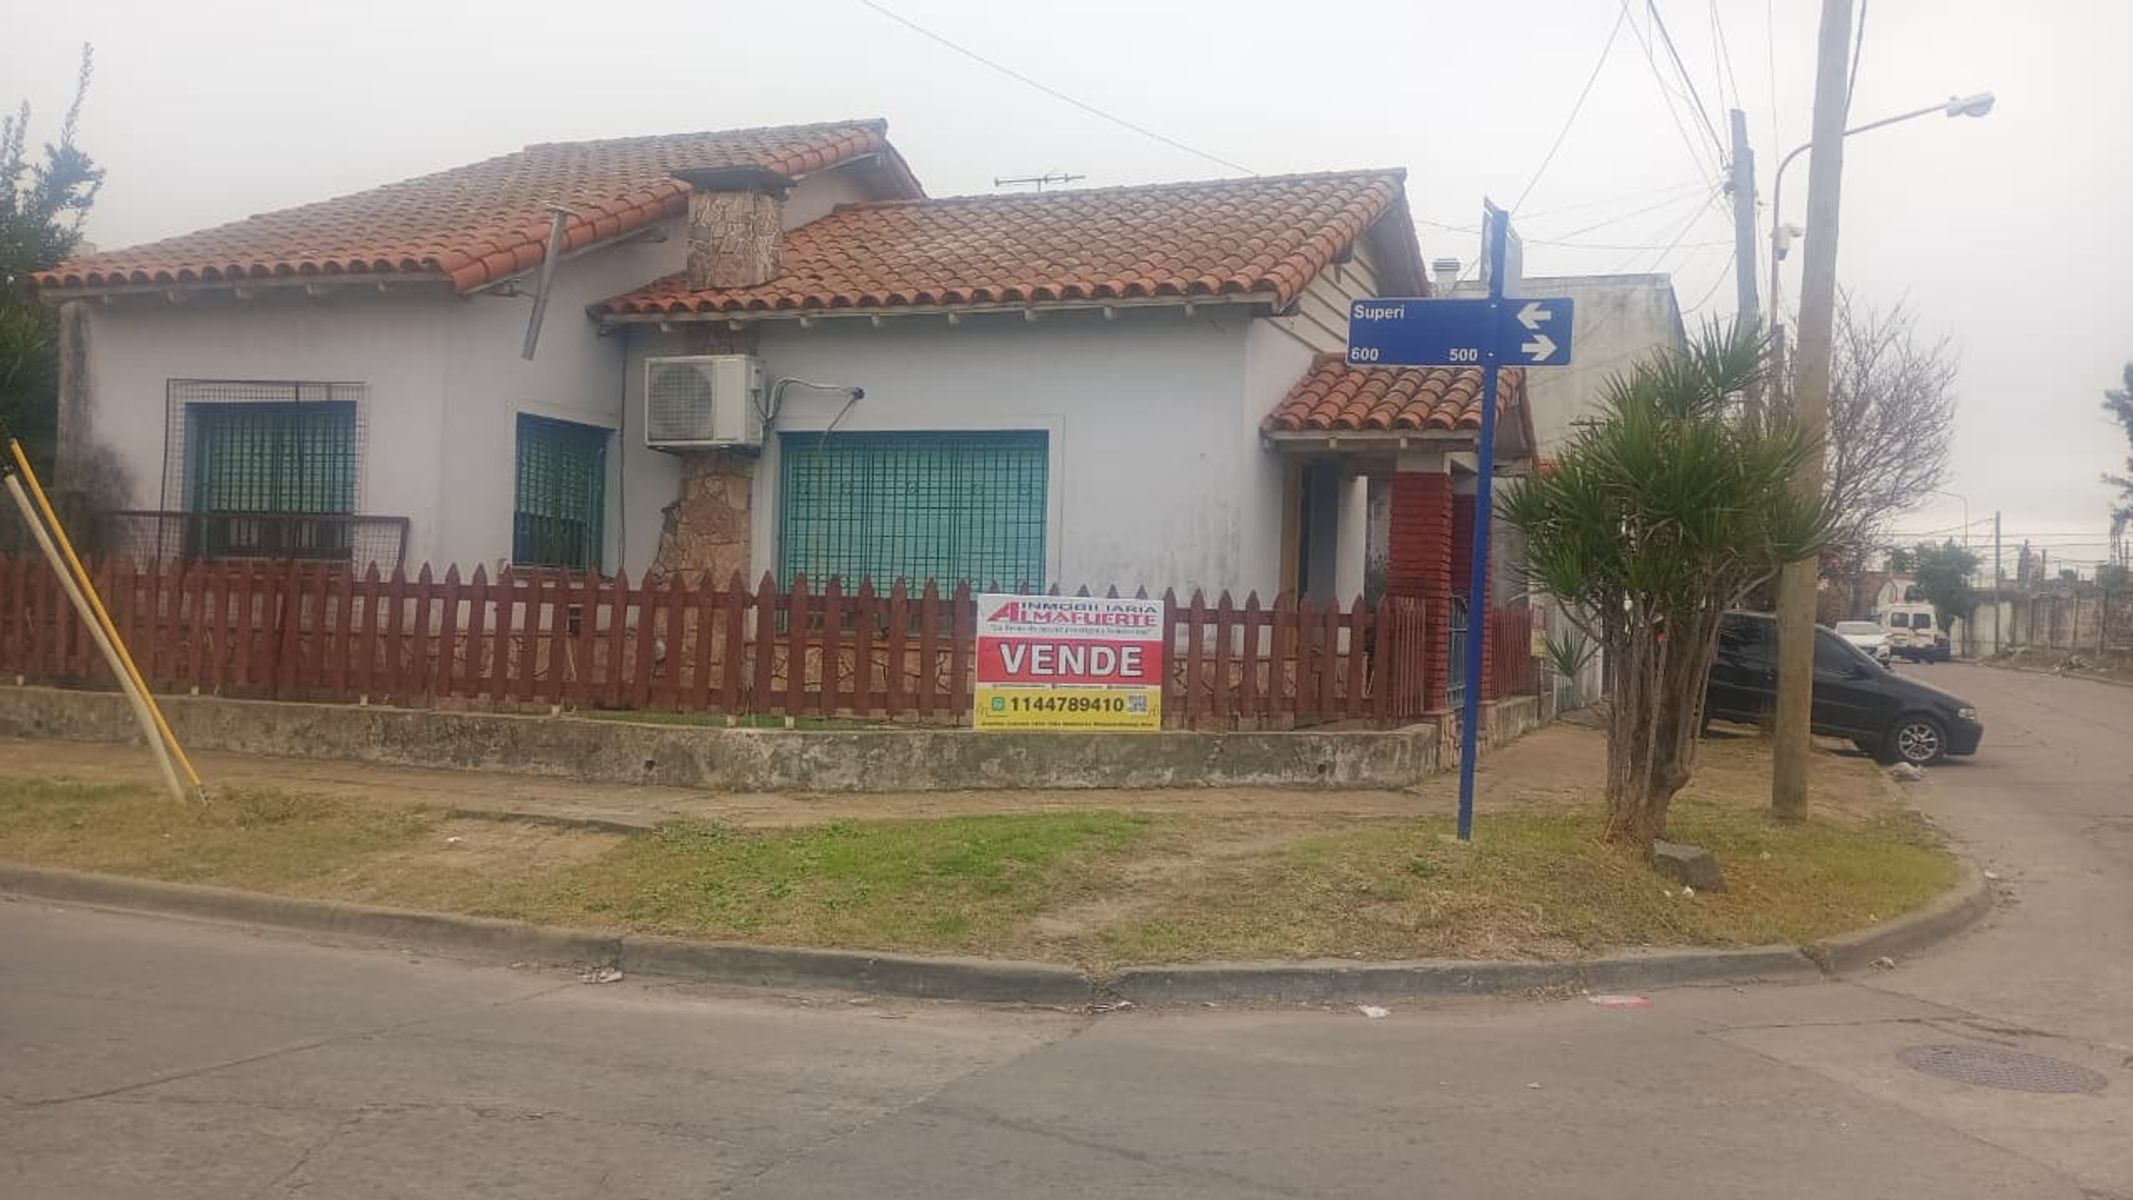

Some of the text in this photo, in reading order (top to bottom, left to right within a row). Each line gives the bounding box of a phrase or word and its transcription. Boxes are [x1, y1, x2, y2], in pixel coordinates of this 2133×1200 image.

[1351, 347, 1478, 362] 600 500
[987, 601, 1158, 627] ALMAFUERTE
[1020, 601, 1158, 613] INMOBILIARIA
[999, 642, 1144, 677] VENDE
[1010, 696, 1125, 713] 1144789410
